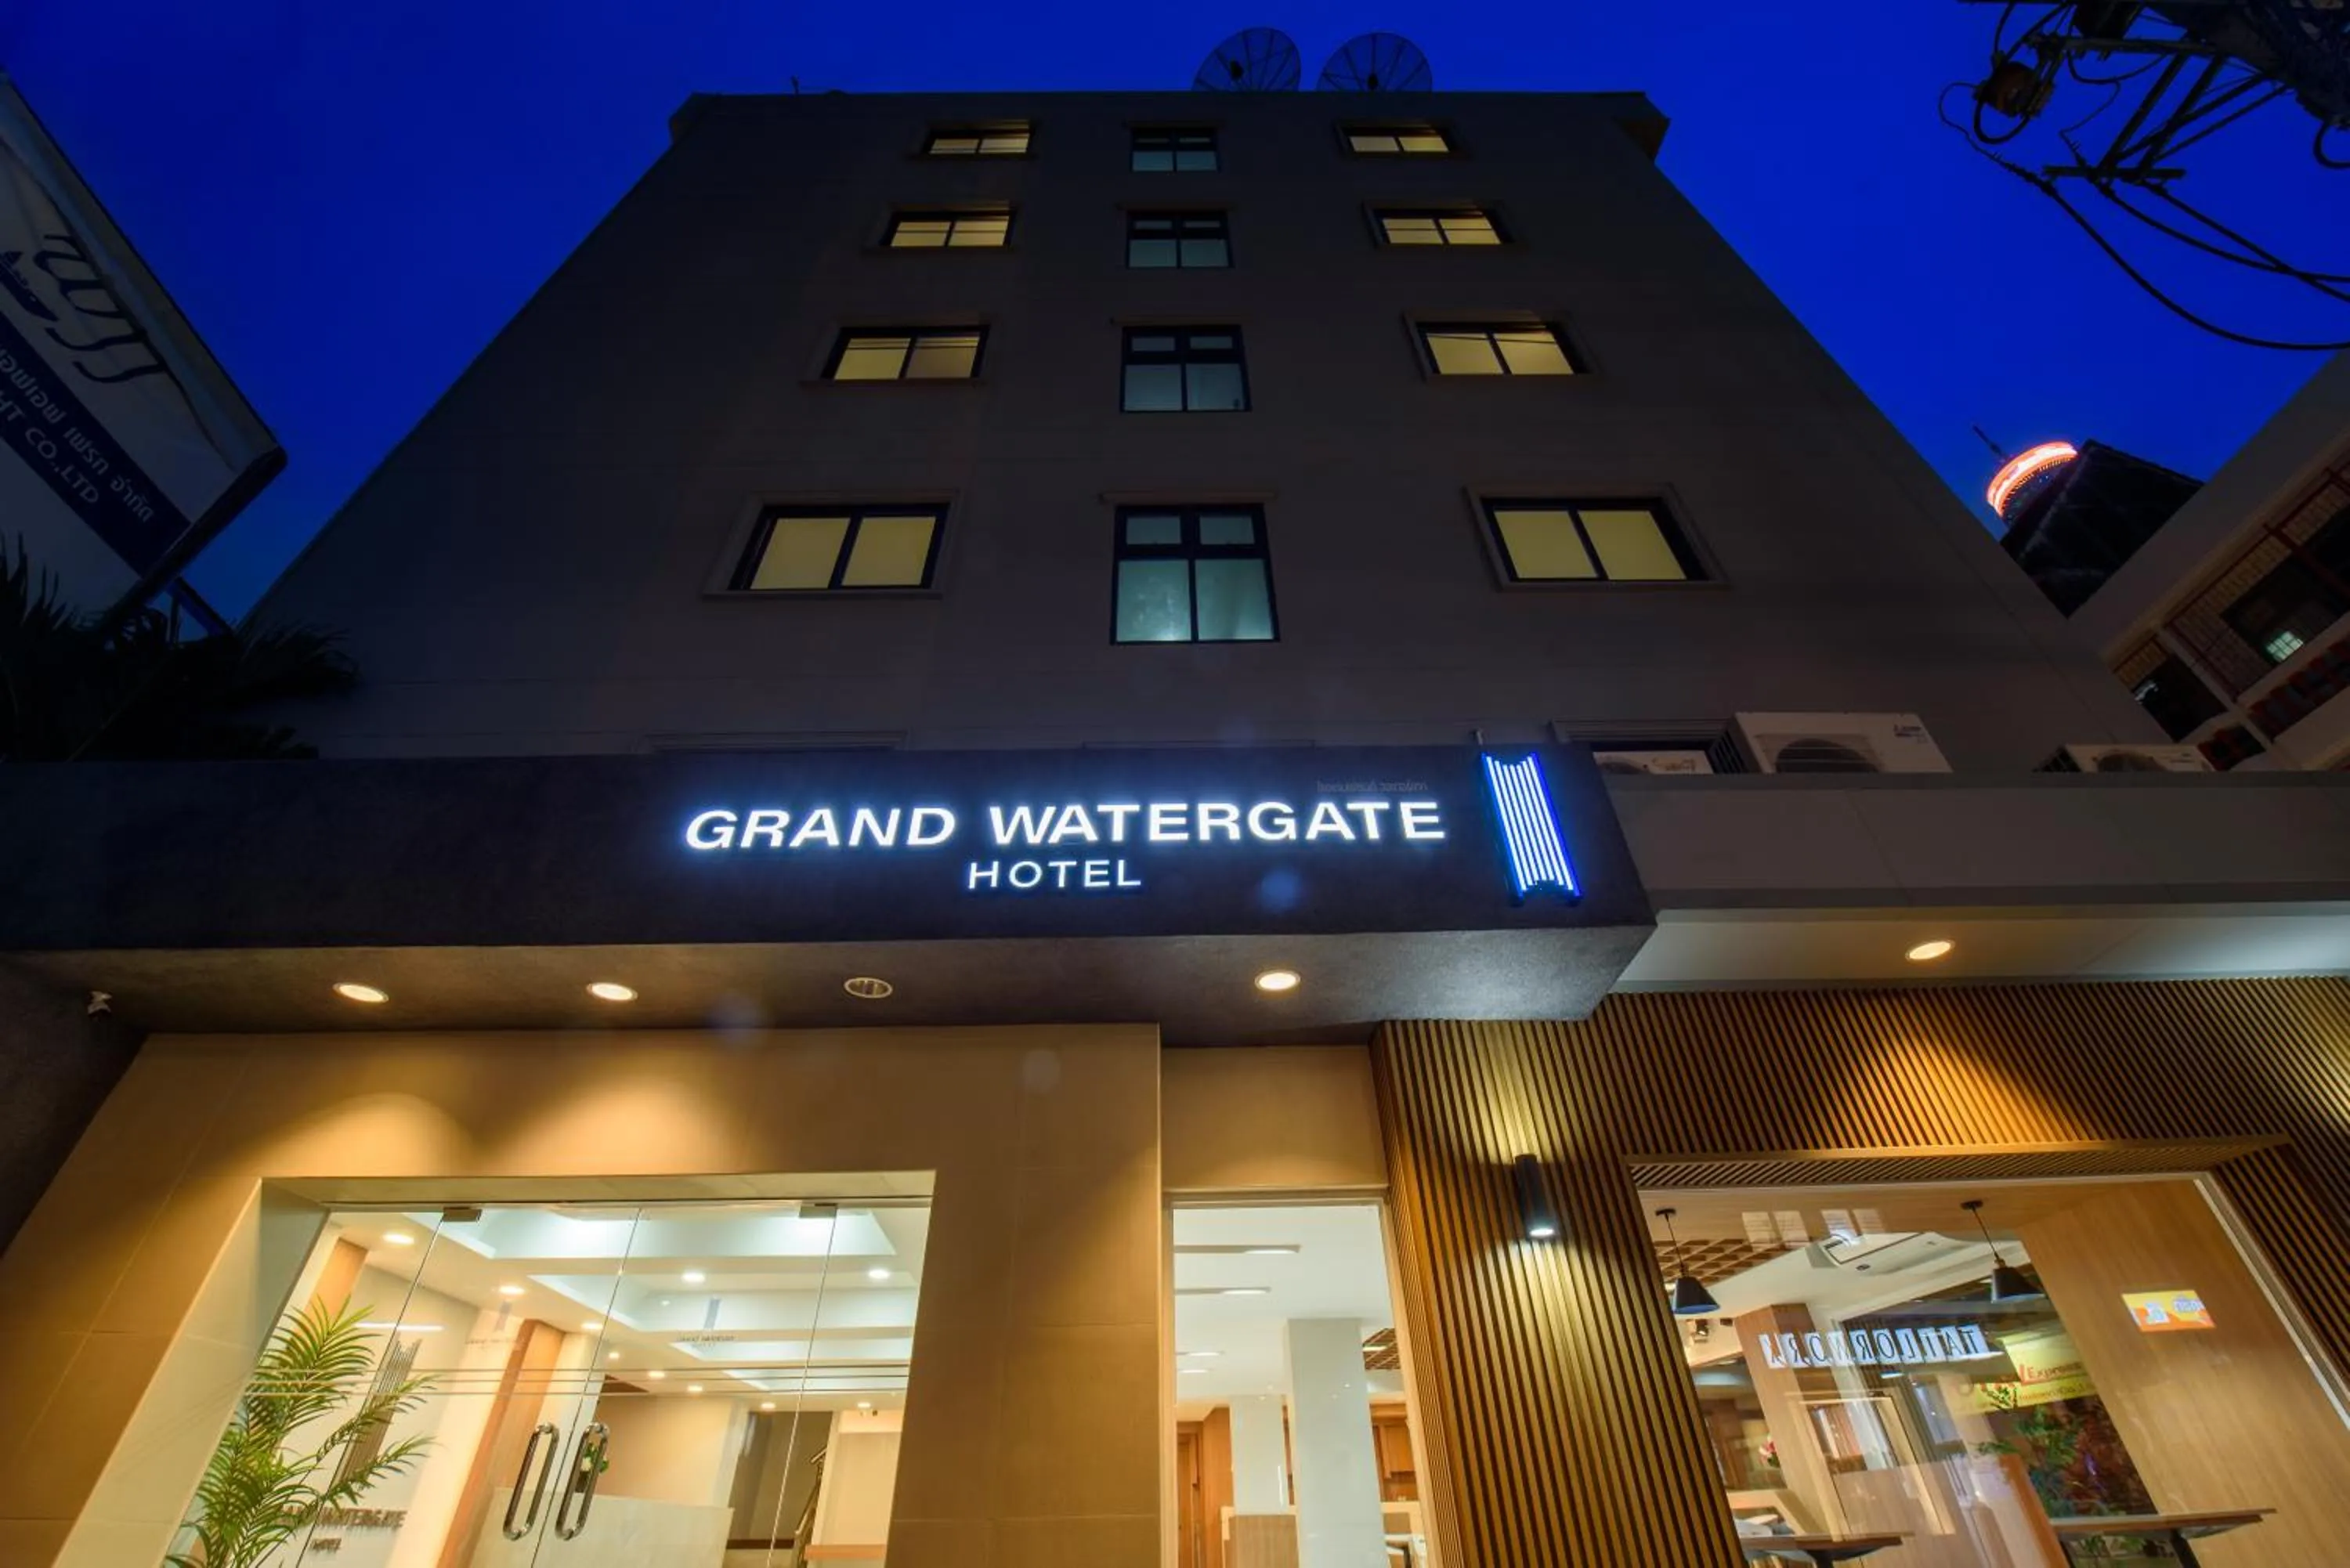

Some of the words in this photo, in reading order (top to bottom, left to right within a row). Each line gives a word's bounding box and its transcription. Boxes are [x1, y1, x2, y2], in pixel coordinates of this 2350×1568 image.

[685, 807, 956, 850] GRAND
[989, 801, 1445, 845] WATERGATE
[969, 860, 1141, 889] HOTEL
